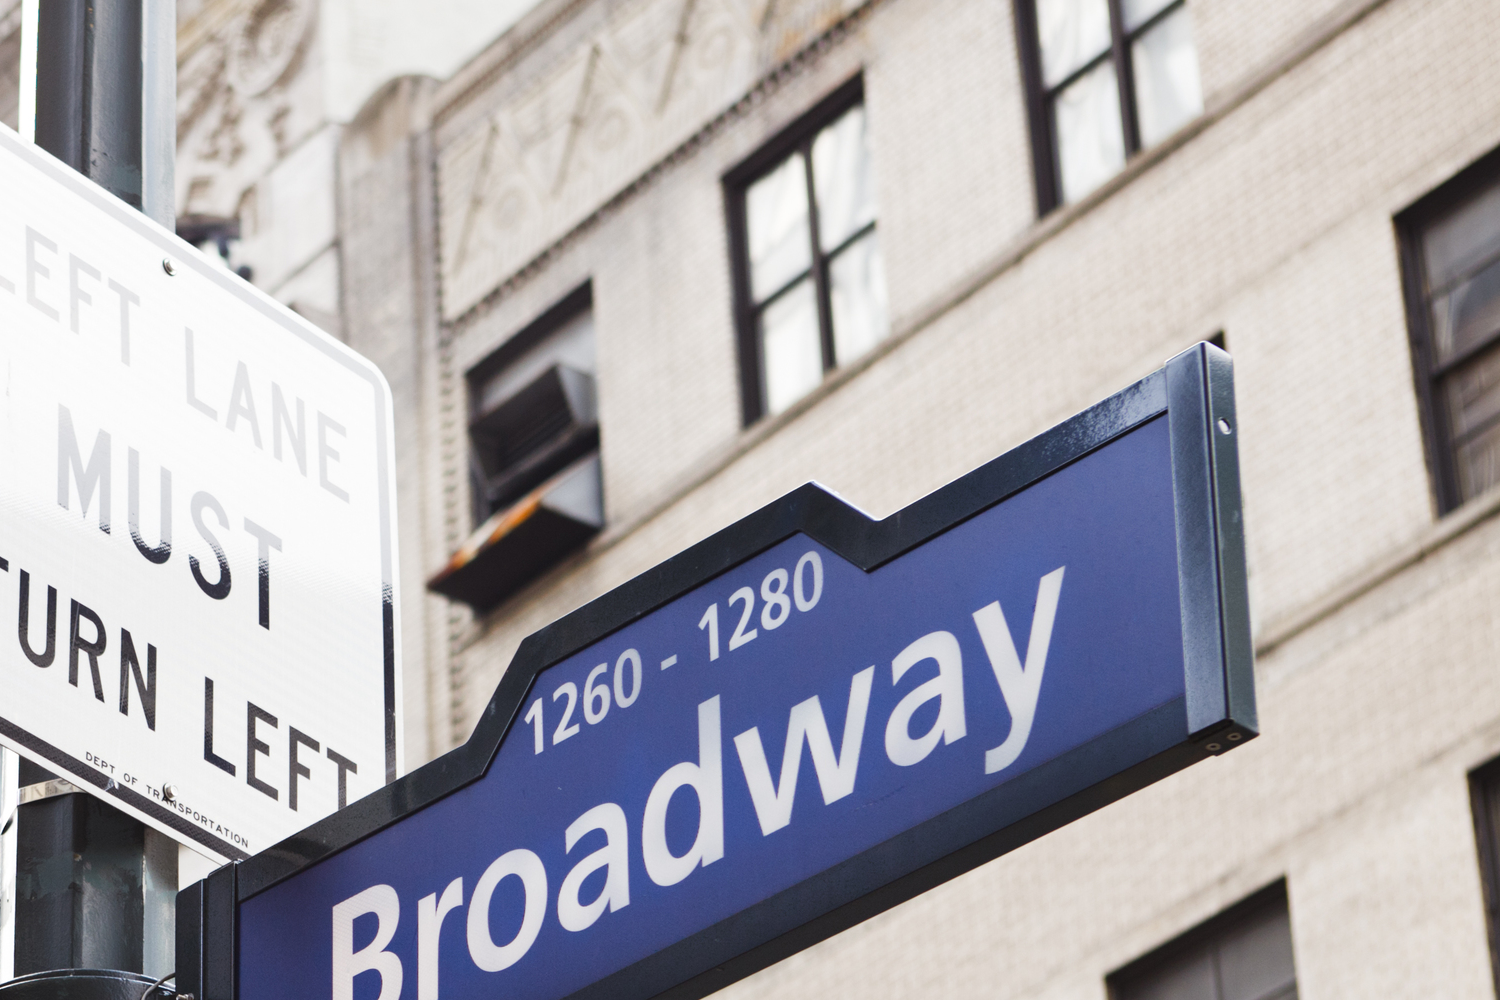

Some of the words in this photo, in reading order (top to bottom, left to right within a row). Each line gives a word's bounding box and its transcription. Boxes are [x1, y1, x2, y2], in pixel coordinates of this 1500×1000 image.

[184, 326, 350, 504] LANE
[57, 403, 283, 632] MUST
[524, 648, 643, 754] 1260
[697, 550, 824, 662] 1280
[85, 751, 116, 774] DEPT
[123, 773, 139, 786] OF
[203, 676, 358, 811] LEFT
